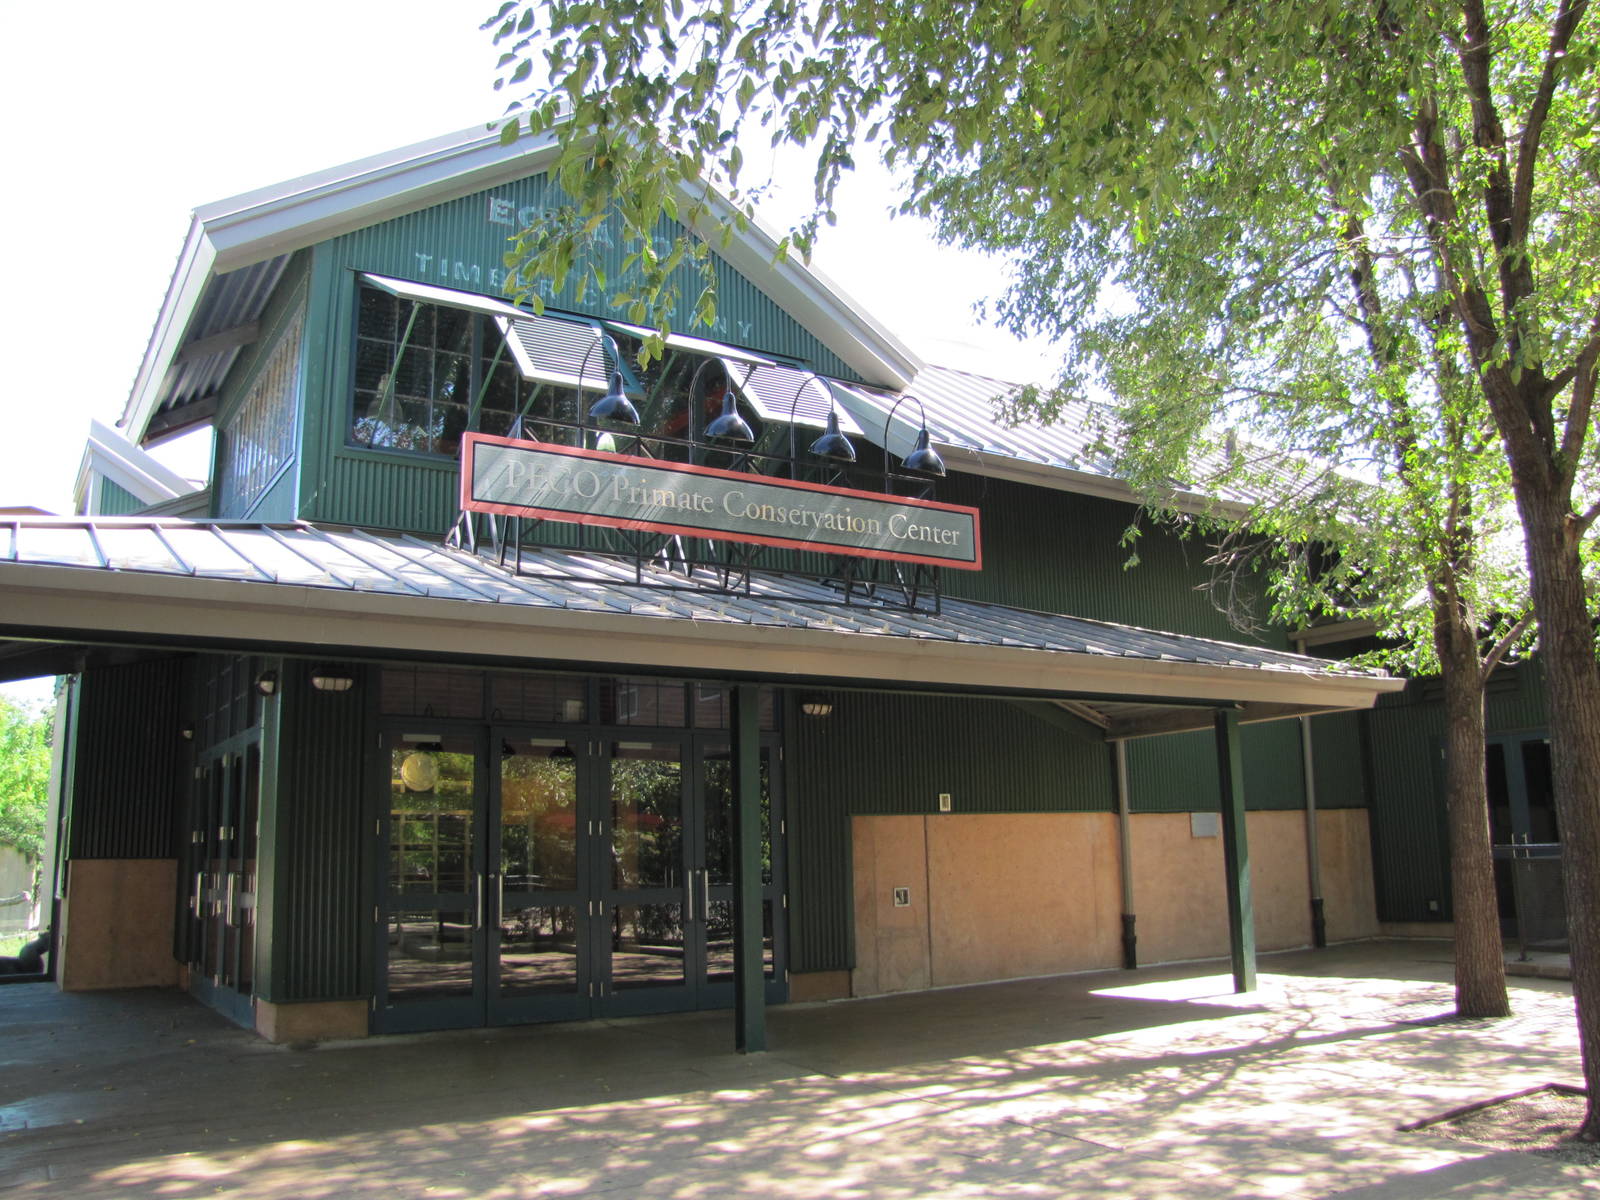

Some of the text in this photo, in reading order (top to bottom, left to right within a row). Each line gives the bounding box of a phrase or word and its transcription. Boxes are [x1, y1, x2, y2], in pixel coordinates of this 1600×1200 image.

[506, 460, 960, 545] PECO Primate Conservation Center
